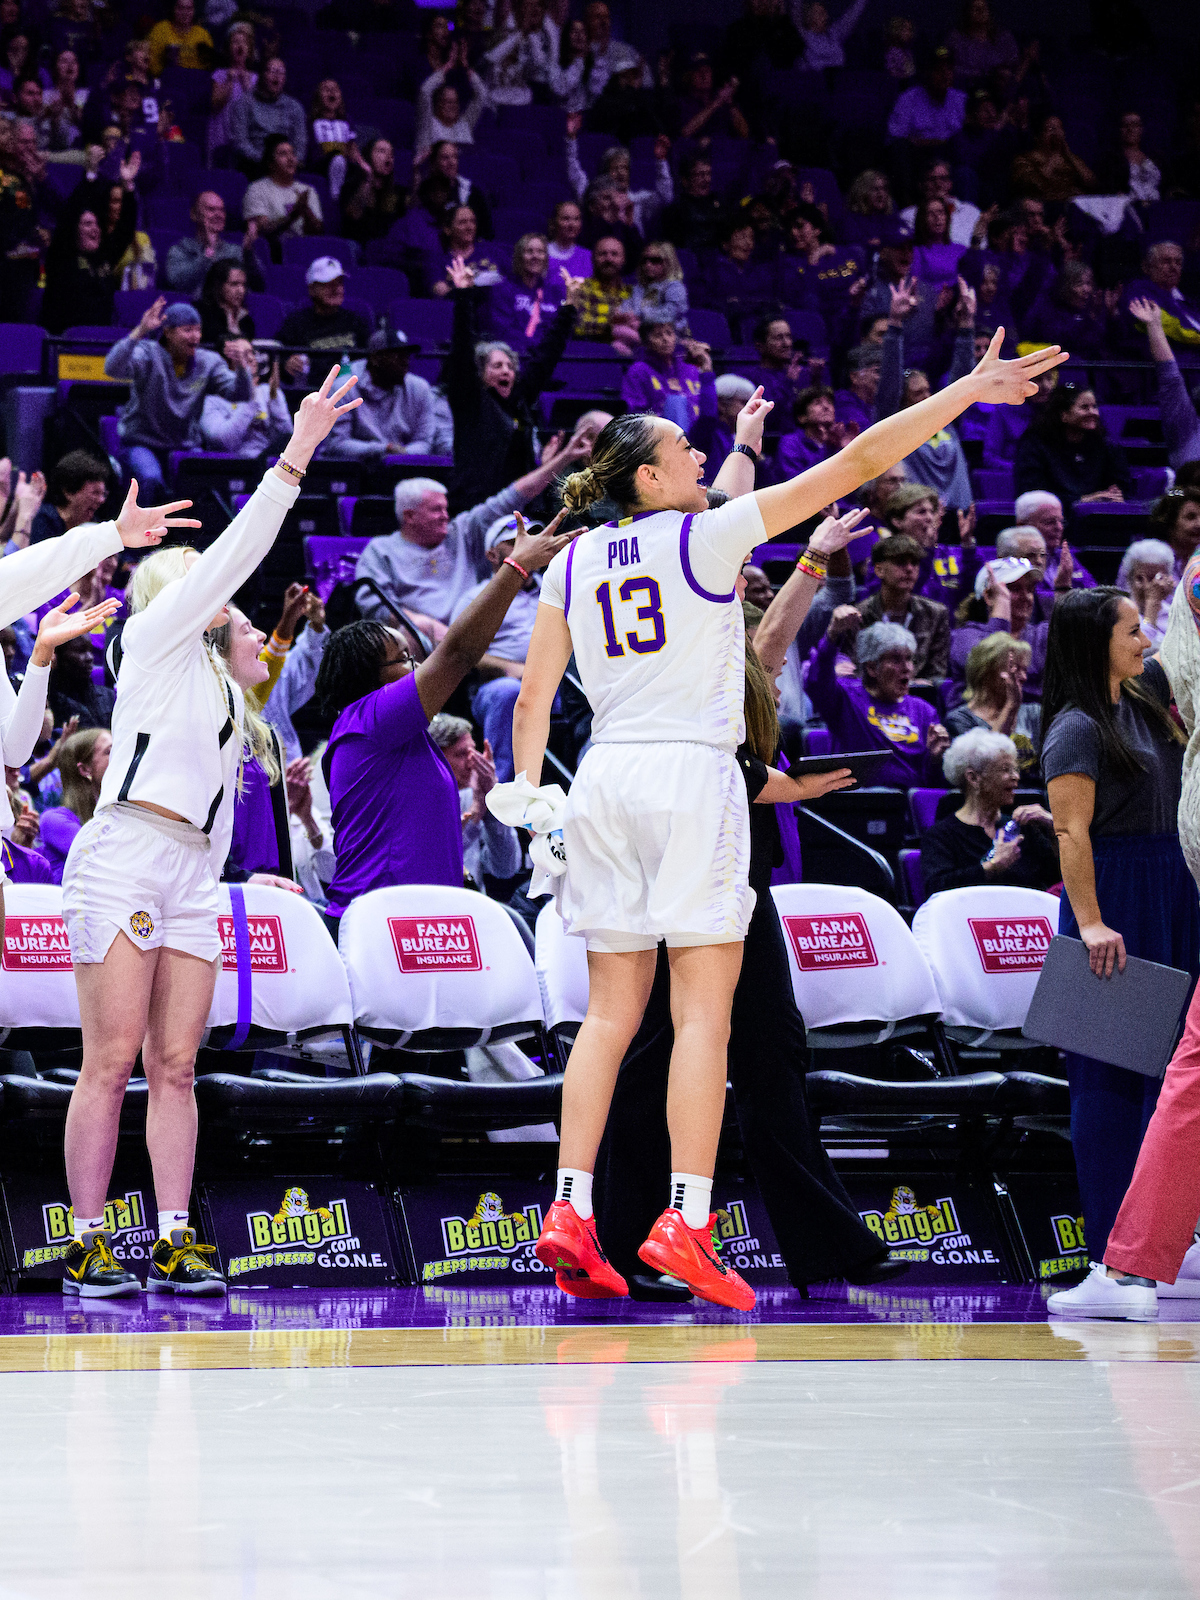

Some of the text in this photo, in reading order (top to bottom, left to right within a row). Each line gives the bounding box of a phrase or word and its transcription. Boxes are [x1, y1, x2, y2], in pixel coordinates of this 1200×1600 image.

[608, 536, 641, 569] POA
[595, 575, 668, 659] 13
[21, 922, 68, 936] FARM
[222, 922, 273, 936] FRM
[416, 922, 466, 936] FARM
[810, 920, 859, 935] FARM
[995, 924, 1044, 937] FARM
[5, 936, 71, 951] BUREAU
[401, 936, 469, 952] BUREAU
[797, 933, 864, 950] BUREAU
[982, 937, 1049, 952] BUREAU
[222, 954, 278, 965] INSANCE
[416, 955, 472, 965] INSURANCE
[814, 951, 868, 962] INSURANCE
[999, 955, 1046, 965] INSURANC
[253, 1204, 346, 1247] Bengal
[864, 1201, 955, 1242] Bengal
[122, 1229, 155, 1246] .com
[447, 1209, 540, 1251] Bengal
[327, 1237, 360, 1254] .com
[726, 1237, 760, 1255] .com
[940, 1234, 971, 1251] .com
[113, 1246, 154, 1260] G.O.
[932, 1250, 1000, 1265] G.O.N.E.
[228, 1252, 387, 1276] KEEPS PESTS G.O.N.E.
[423, 1256, 553, 1281] KEEPS PESTS G.O.
[1040, 1256, 1080, 1278] KEEPS
